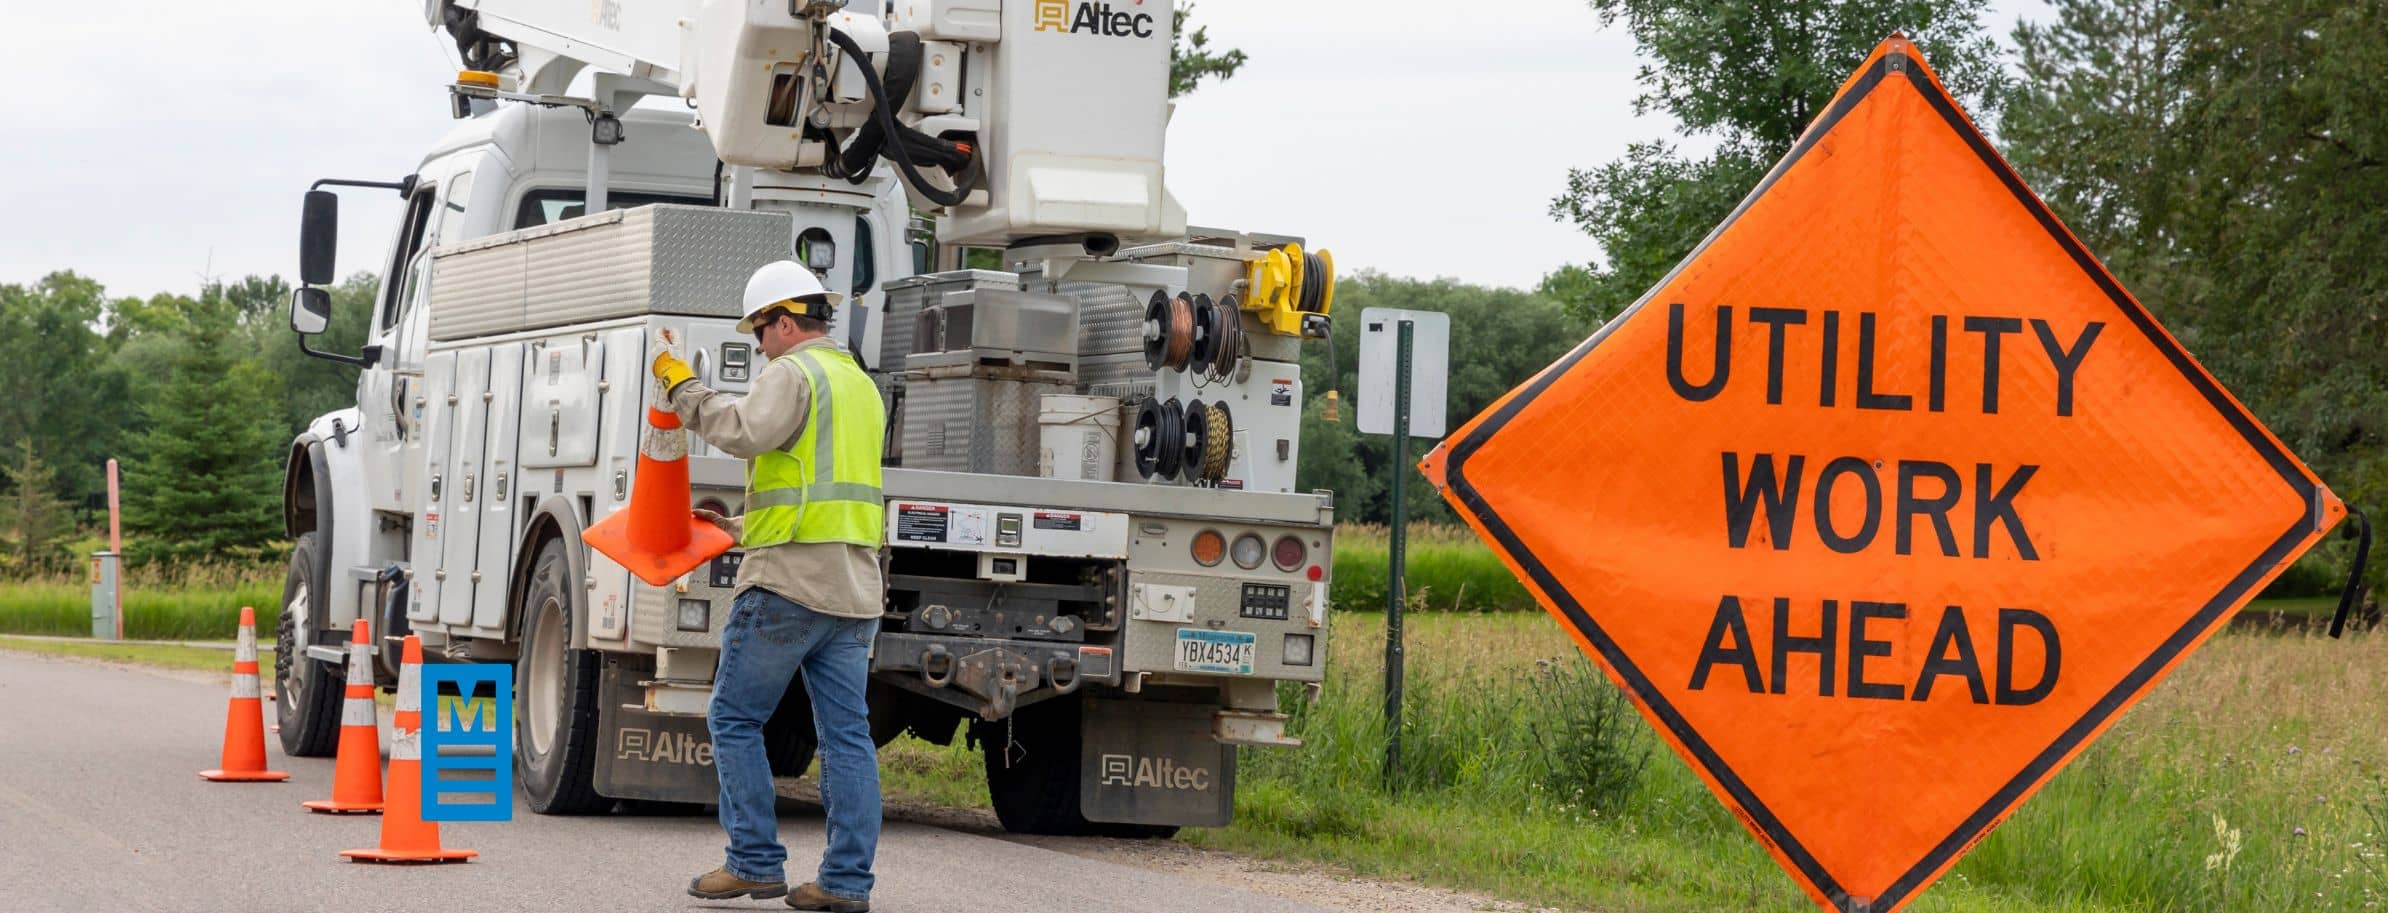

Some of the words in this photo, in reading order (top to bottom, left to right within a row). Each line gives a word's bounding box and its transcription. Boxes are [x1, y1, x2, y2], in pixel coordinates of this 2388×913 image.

[1070, 0, 1153, 38] Altec
[1666, 303, 2106, 417] UTILITY
[1721, 451, 2040, 561] WORK
[1183, 640, 1240, 665] YBX4534
[1687, 595, 2062, 706] AHEAD
[651, 731, 713, 766] Alte
[1134, 757, 1209, 791] Altec
